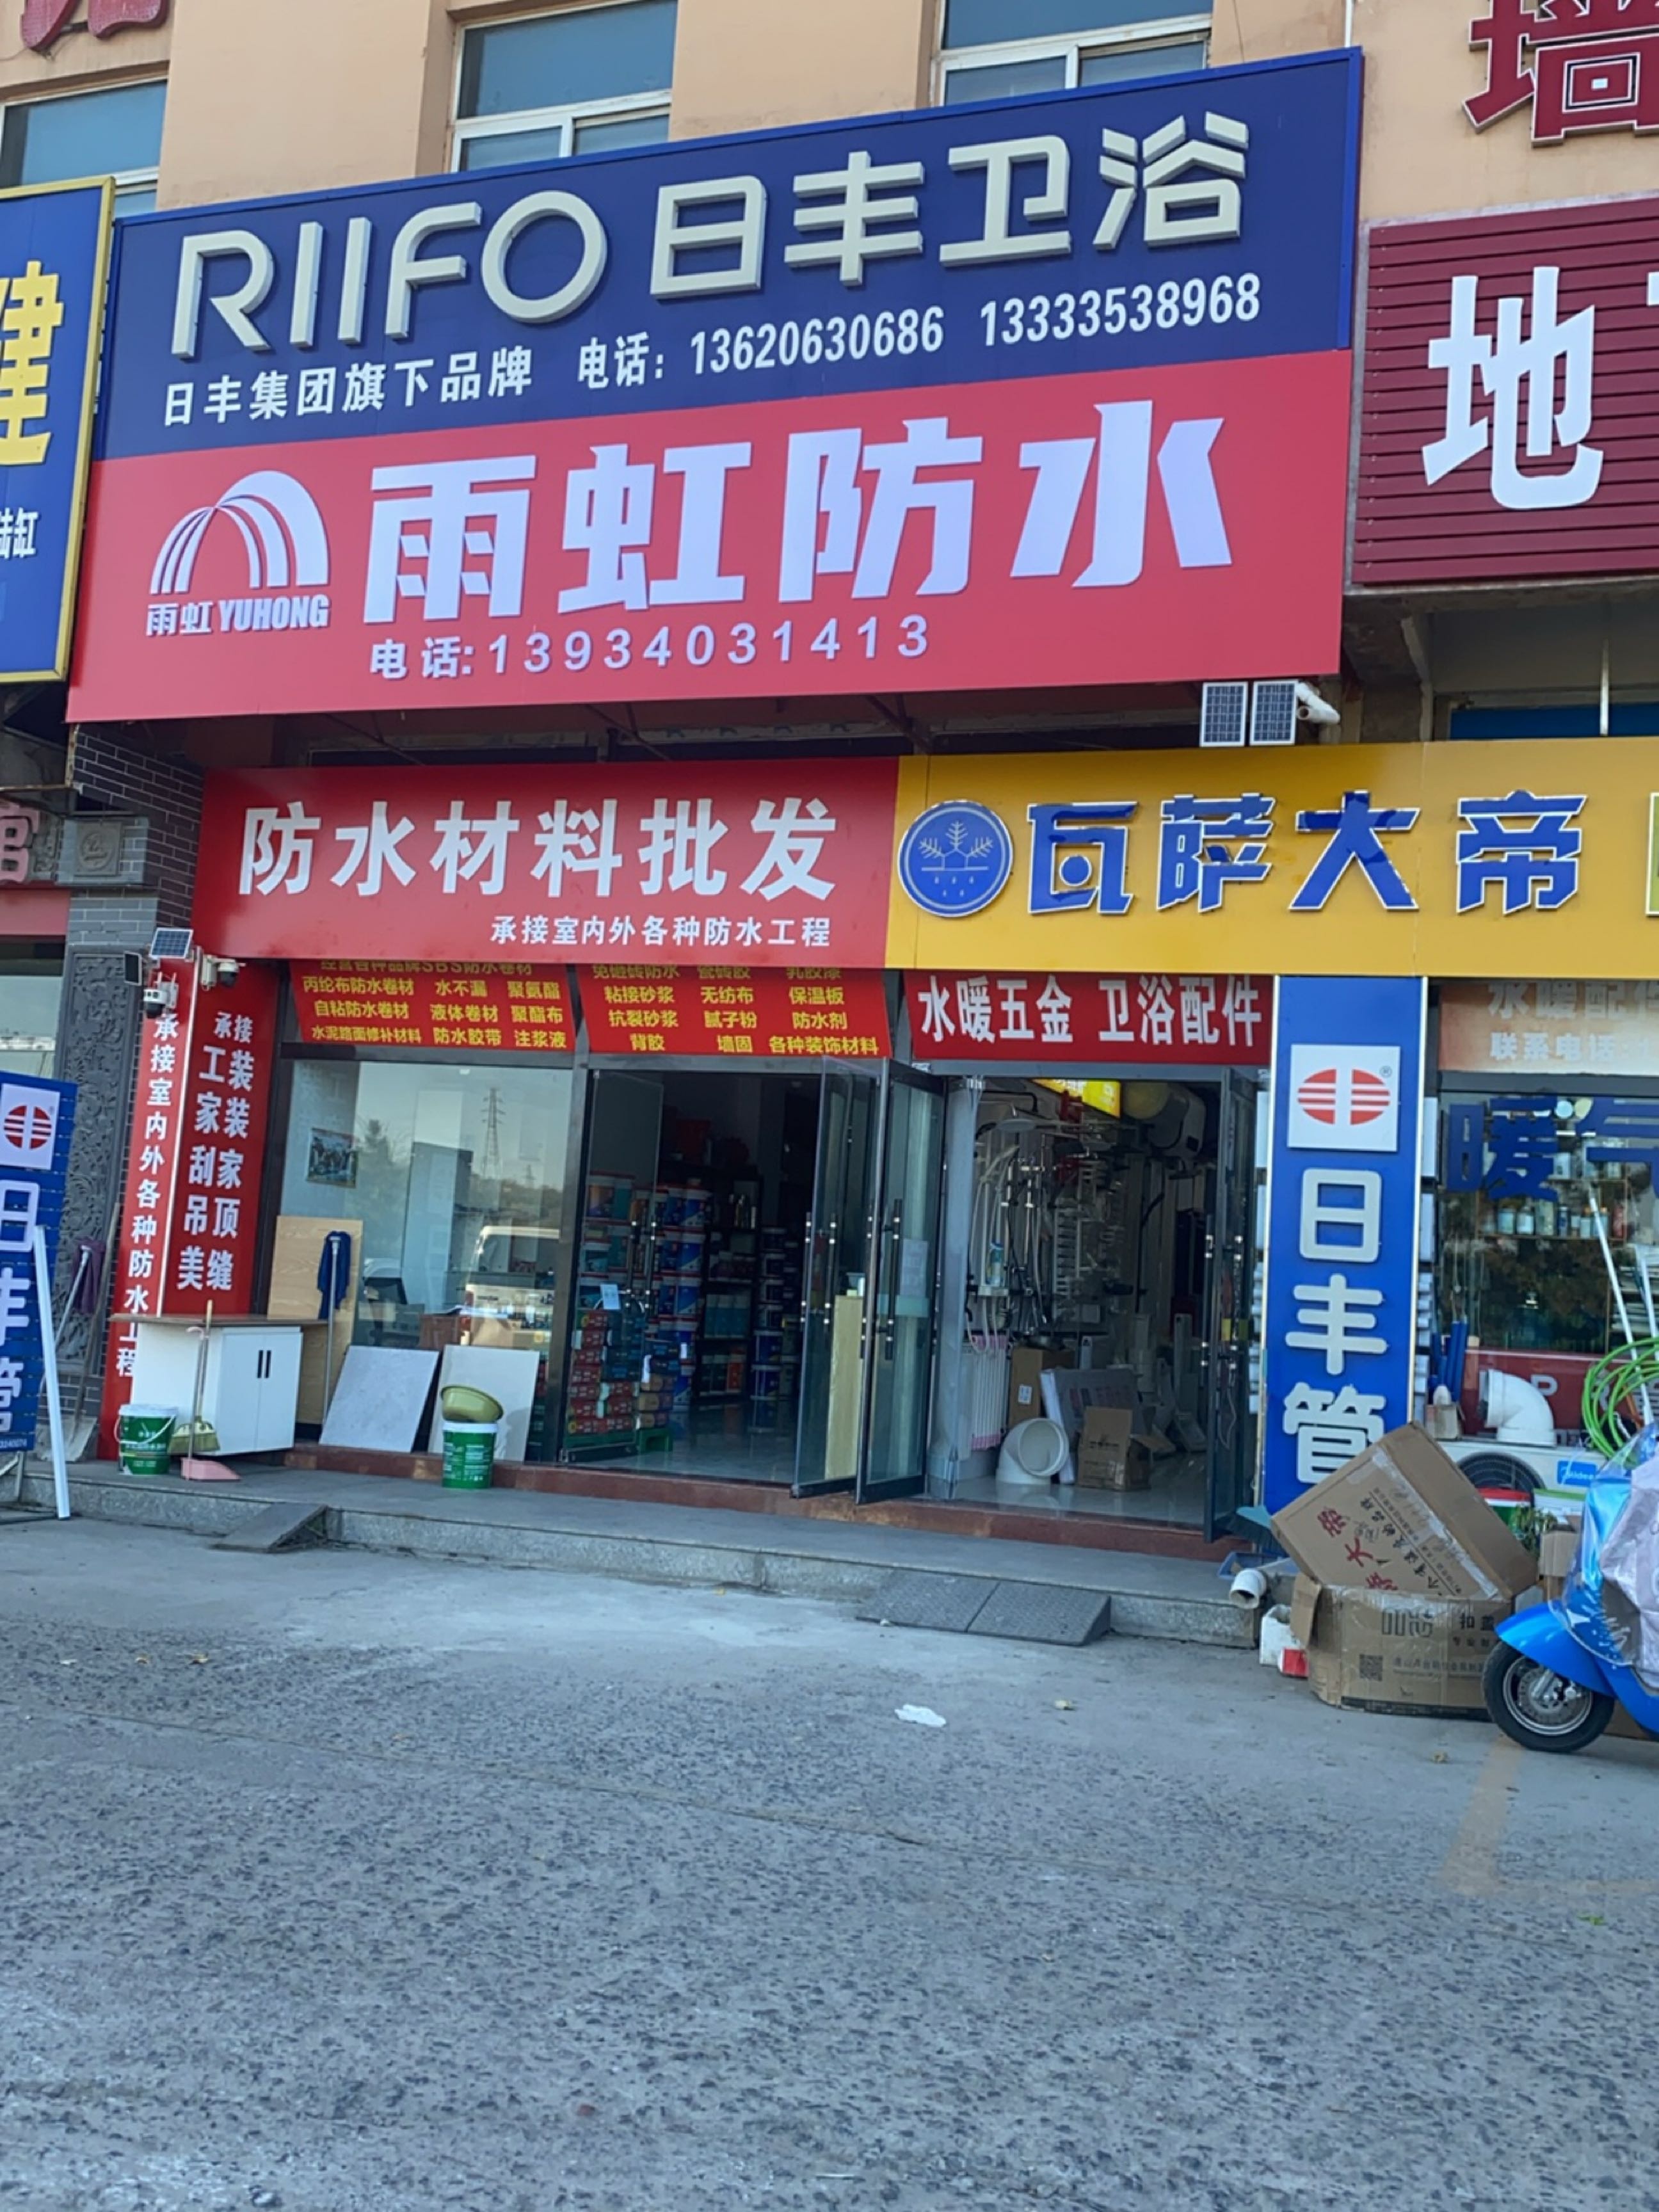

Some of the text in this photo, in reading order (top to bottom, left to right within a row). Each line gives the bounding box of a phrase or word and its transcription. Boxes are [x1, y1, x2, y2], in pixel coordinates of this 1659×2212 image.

[172, 111, 1249, 361] RIIFO 日丰卫浴
[164, 346, 533, 426] 日丰集团旗下品牌
[691, 307, 944, 374] 13620630686
[981, 273, 1260, 346] 13333538968
[363, 399, 1233, 624] 雨虹防水
[145, 593, 330, 636] 雨虹 YUHONG
[238, 797, 837, 901] 防水材料批发
[1027, 790, 1587, 916] 瓦萨大帝
[490, 915, 830, 947] 承接室内外各种防水工程
[314, 1000, 564, 1024] 自粘防水卷材 液体卷材 聚酯布
[435, 979, 488, 998] 水不漏
[507, 981, 561, 1000] 聚氨酯
[604, 986, 845, 1006] 粘接砂浆 无纺布 保温板
[918, 975, 1262, 1047] 水暖五金 卫浴配件
[214, 1011, 253, 1043] 承接
[432, 1026, 502, 1046] 防水胶带
[513, 1029, 568, 1048] 注浆液
[608, 1009, 848, 1030] 抗裂砂浆 腻子粉 防水剂
[629, 1033, 879, 1056] 背胶 墙固 各种装饰材料
[198, 1045, 255, 1092] 工装
[194, 1091, 250, 1139] 家装
[188, 1145, 244, 1190] 刮家
[184, 1194, 241, 1238] 吊顶
[177, 1245, 234, 1291] 美缝
[1283, 1167, 1388, 1484] 日丰管
